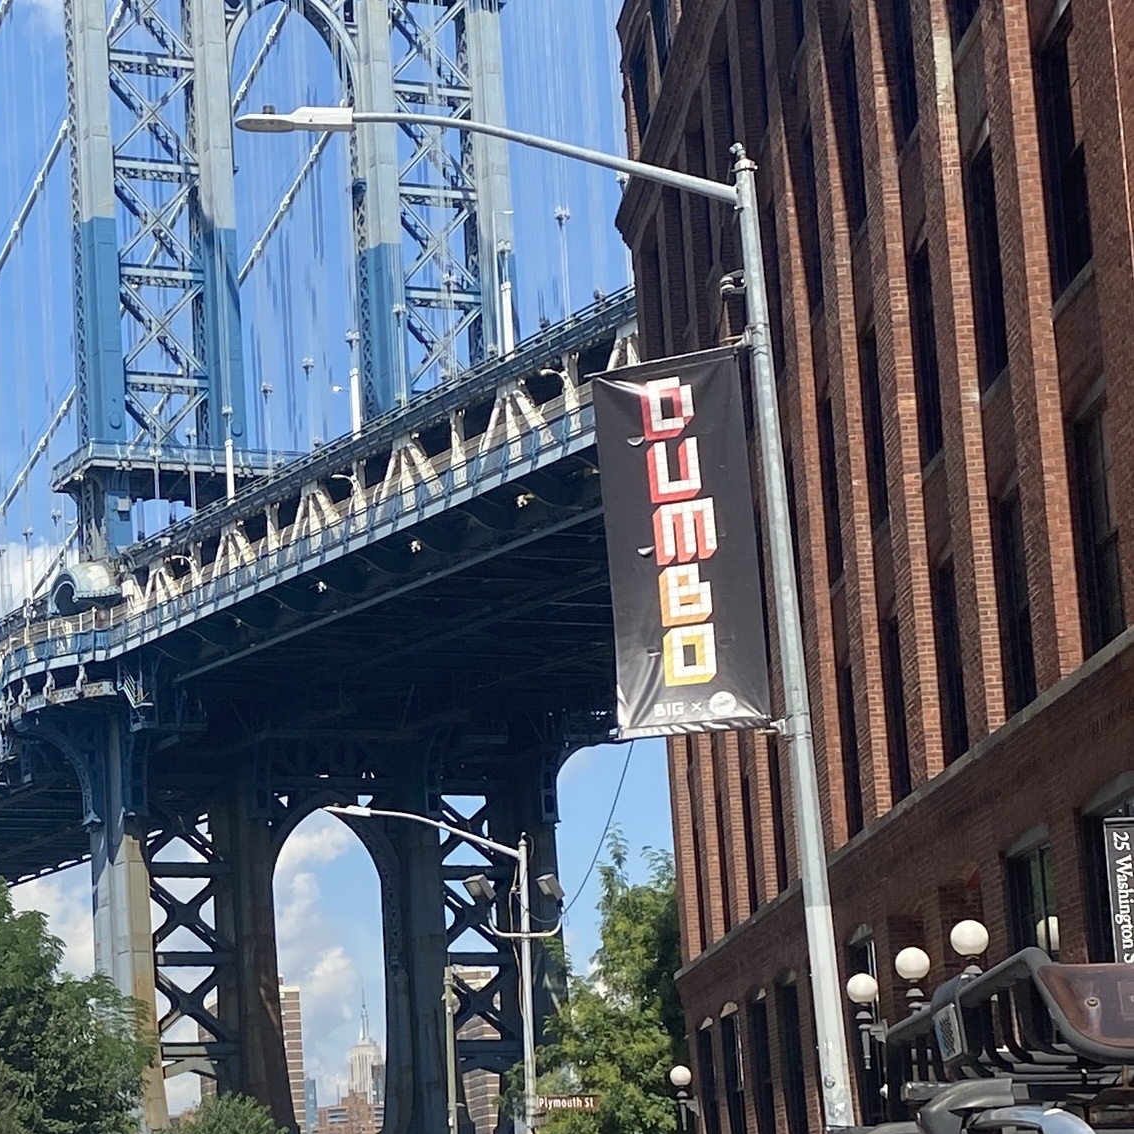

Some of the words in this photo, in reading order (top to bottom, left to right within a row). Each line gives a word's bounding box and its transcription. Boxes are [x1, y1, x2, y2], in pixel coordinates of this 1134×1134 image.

[640, 376, 718, 687] DUMBO
[654, 701, 684, 717] BIG
[1112, 831, 1131, 851] 25
[1114, 853, 1134, 950] Washington
[539, 1096, 583, 1110] Plymouth
[584, 1096, 594, 1108] St
